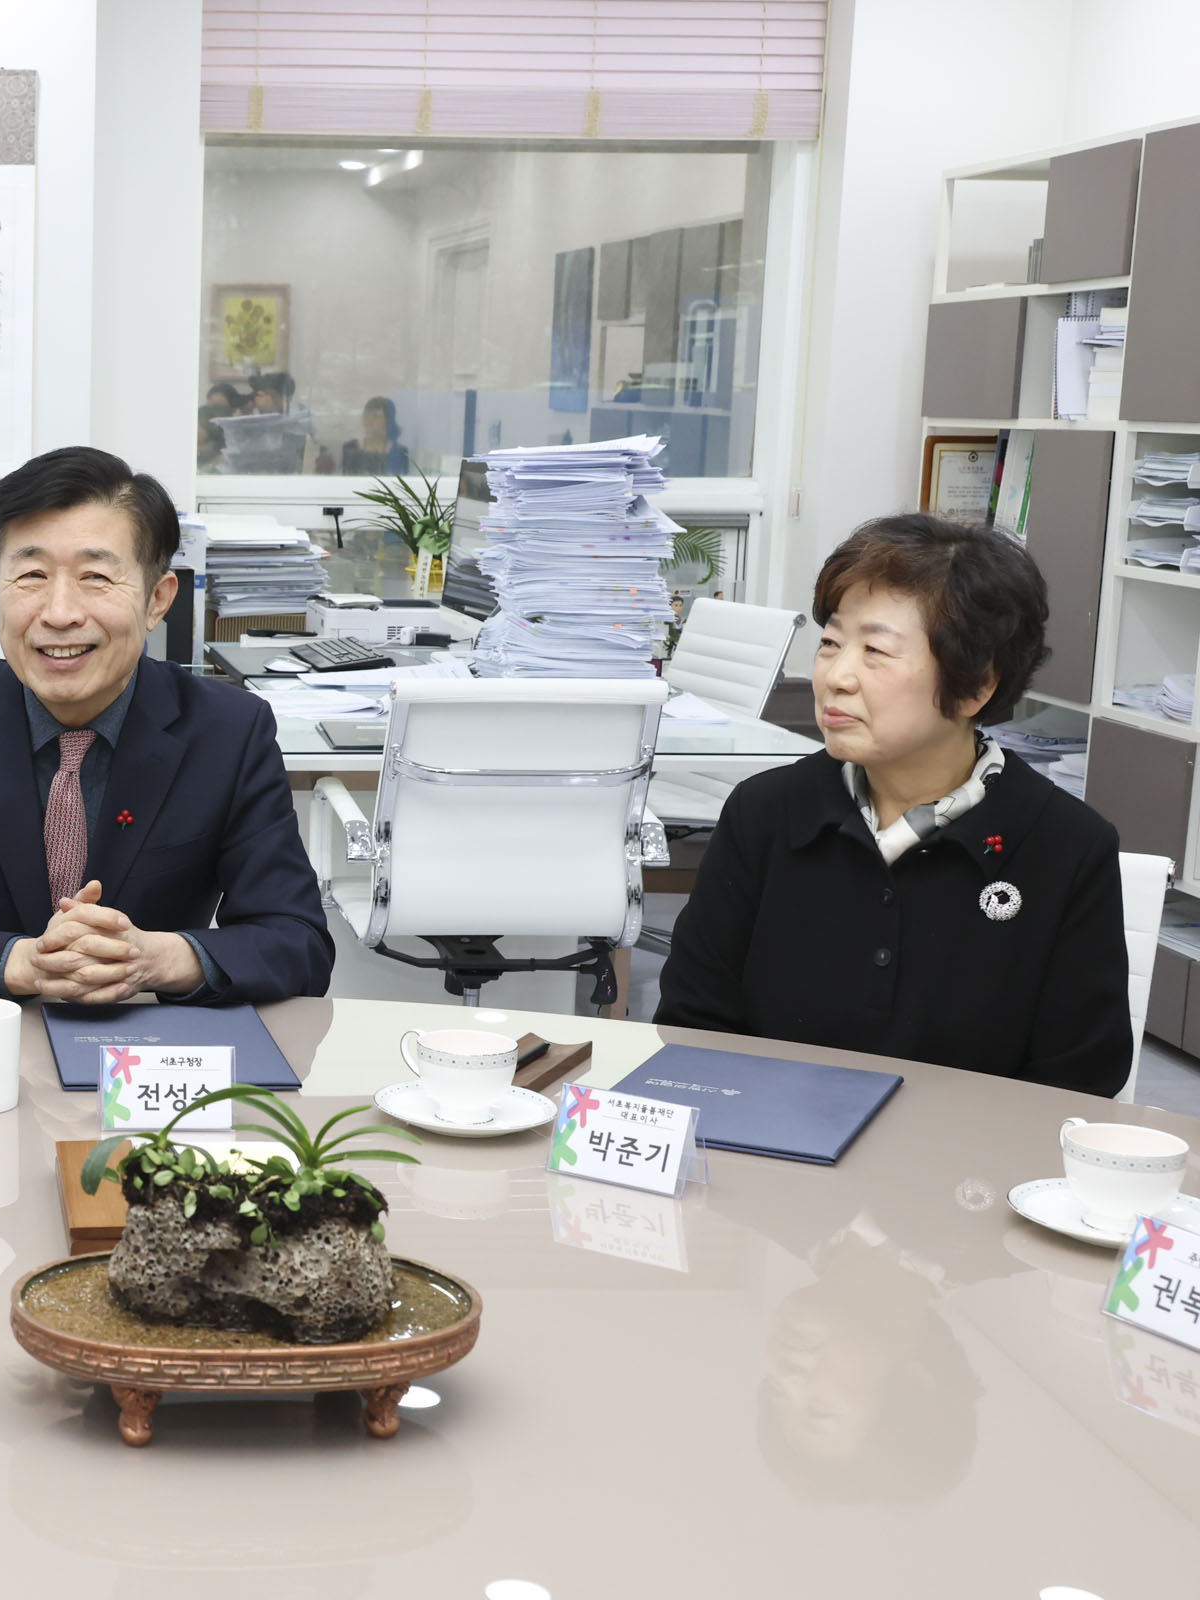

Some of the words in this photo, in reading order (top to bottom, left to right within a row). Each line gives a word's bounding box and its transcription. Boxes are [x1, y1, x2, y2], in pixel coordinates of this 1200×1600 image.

[160, 1056, 203, 1067] 서초구청장
[137, 1082, 213, 1112] 전성수
[607, 1097, 675, 1119] 서초복지돌봄재단
[620, 1112, 658, 1126] 대표이사
[588, 1130, 670, 1173] 박준기
